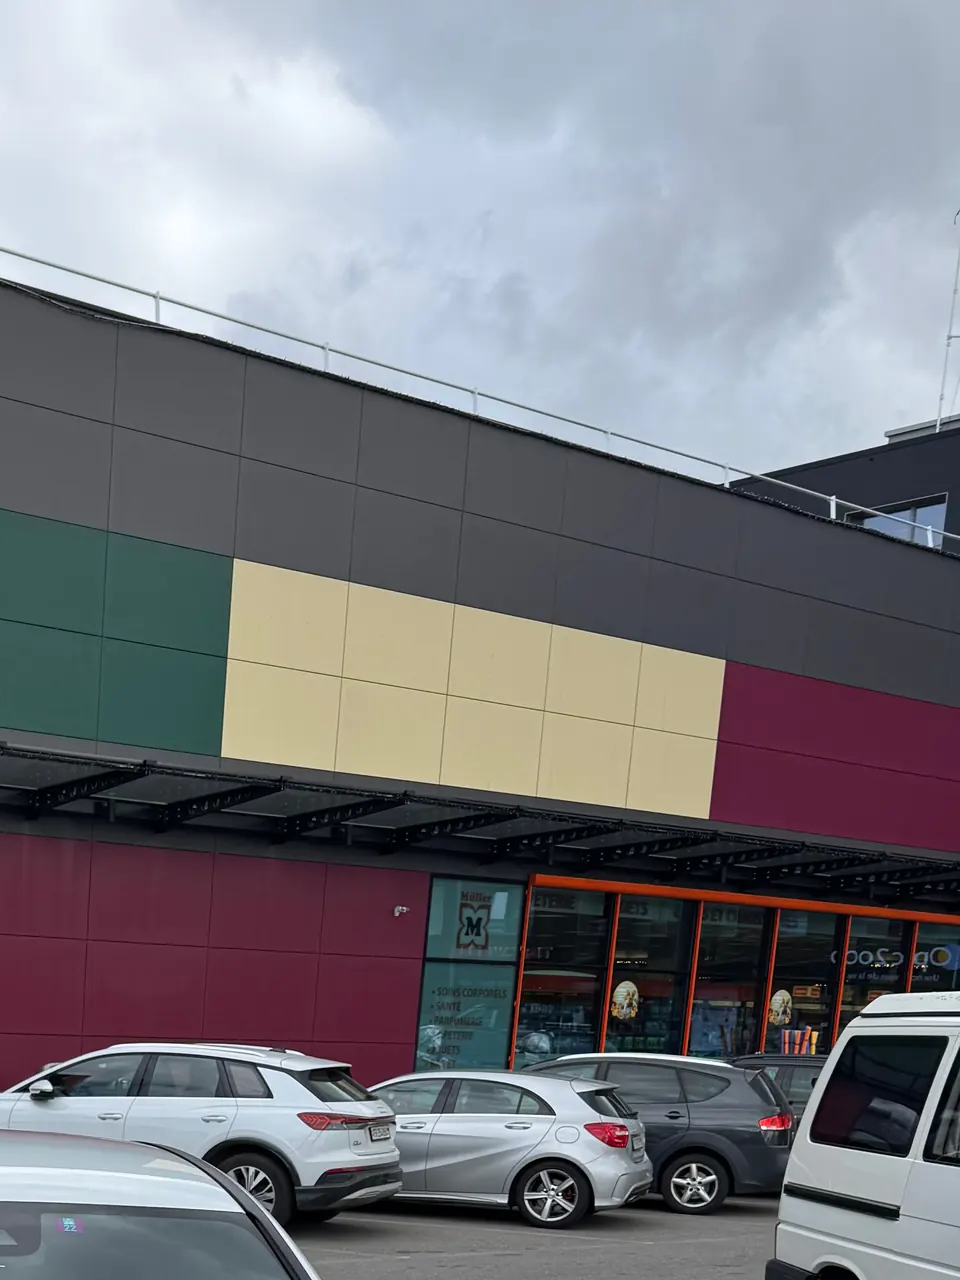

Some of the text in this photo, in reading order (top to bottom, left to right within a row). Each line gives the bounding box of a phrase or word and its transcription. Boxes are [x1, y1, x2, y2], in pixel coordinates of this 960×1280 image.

[464, 916, 483, 937] M
[462, 988, 508, 999] CORPORELS
[63, 1224, 77, 1232] 22
